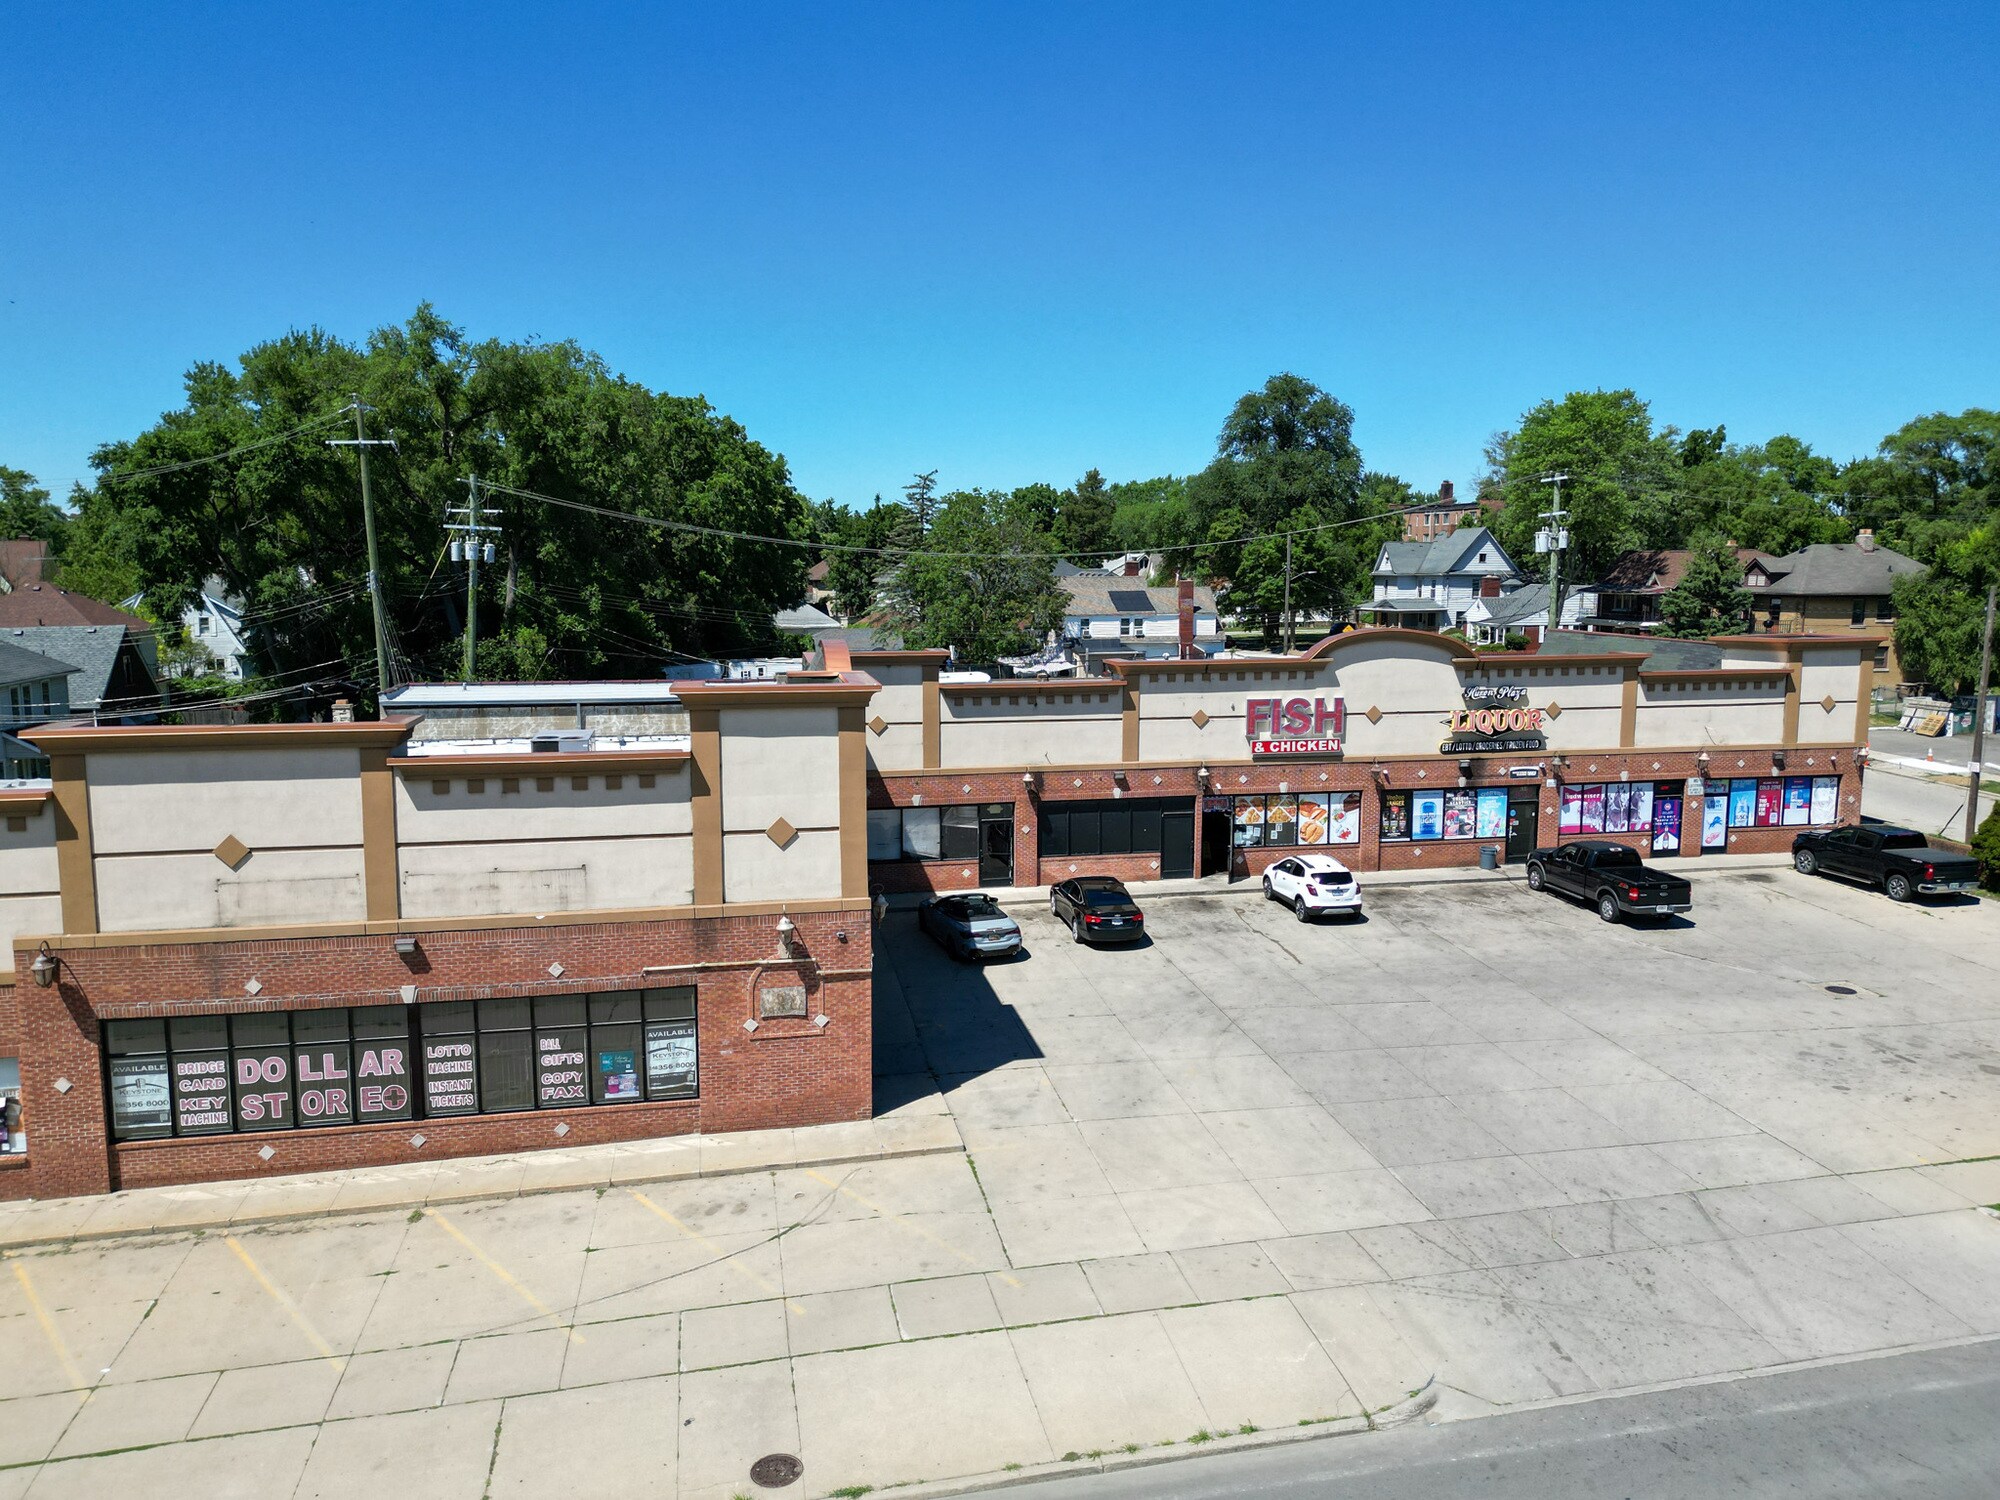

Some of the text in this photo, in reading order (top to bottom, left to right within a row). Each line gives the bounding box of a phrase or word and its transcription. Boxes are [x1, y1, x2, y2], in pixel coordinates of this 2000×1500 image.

[1465, 686, 1527, 702] Huron Plaza
[1246, 697, 1345, 736] FISH
[1451, 709, 1543, 734] LIQUOR
[1254, 739, 1339, 753] & CHICKEN
[648, 1028, 694, 1038] AVAILABLE
[427, 1043, 472, 1058] LOTTO
[540, 1038, 562, 1051] BALL
[541, 1052, 584, 1067] GIFTS
[113, 1063, 167, 1073] AVAILABLE
[177, 1061, 226, 1075] BRIDGE
[428, 1060, 473, 1075] MACHINE
[179, 1077, 227, 1092] CARD
[541, 1071, 584, 1085] COPY
[119, 1088, 163, 1096] KEYSTONE
[428, 1078, 473, 1094] INSTANT
[541, 1085, 585, 1100] FAX
[180, 1096, 227, 1111] KEY
[430, 1093, 474, 1108] TICKETS
[180, 1112, 228, 1127] MACHINE
